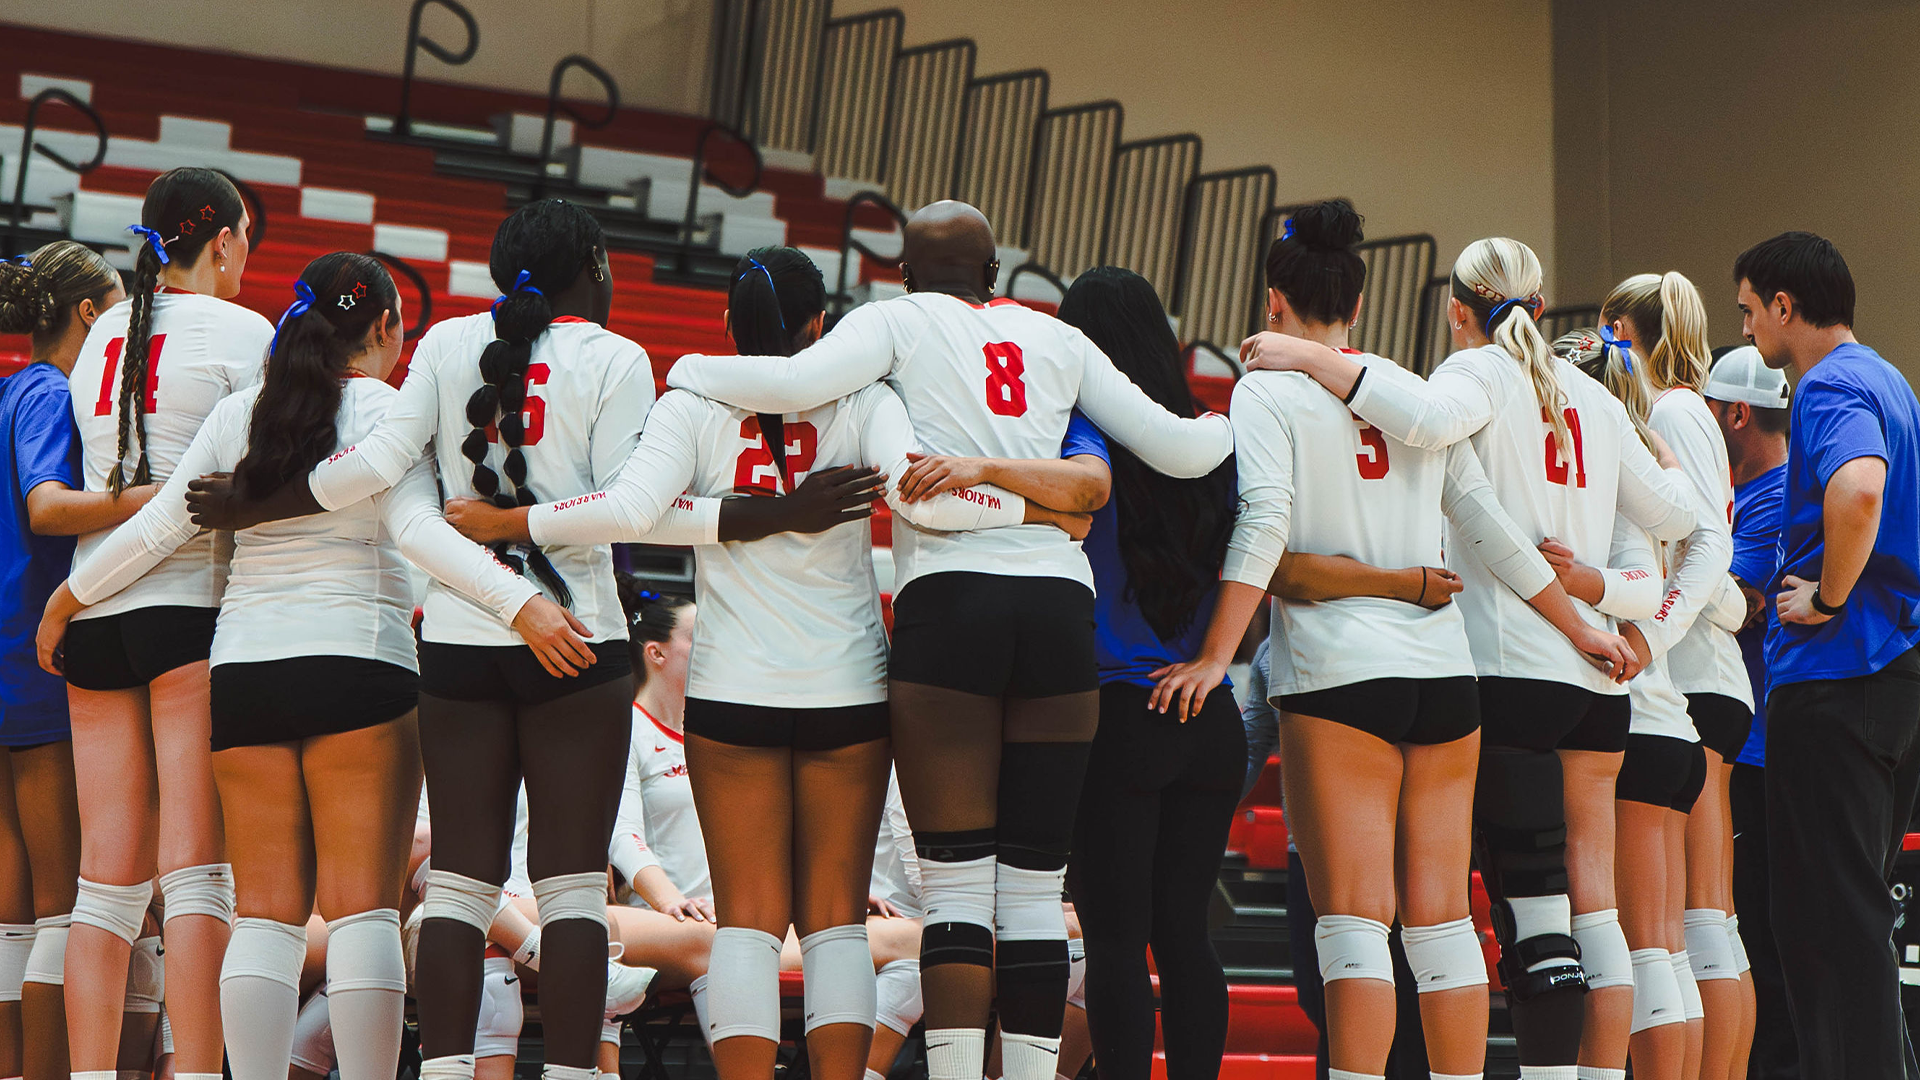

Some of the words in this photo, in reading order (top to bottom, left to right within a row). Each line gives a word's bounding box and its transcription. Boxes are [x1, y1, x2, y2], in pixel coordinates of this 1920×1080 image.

[94, 333, 167, 416] 14
[485, 362, 551, 446] 6
[981, 341, 1028, 418] 8
[733, 415, 817, 497] 22
[1350, 408, 1390, 480] 3
[1541, 404, 1587, 488] 21
[553, 491, 607, 513] WARRIORS
[951, 484, 1002, 510] WARIORS
